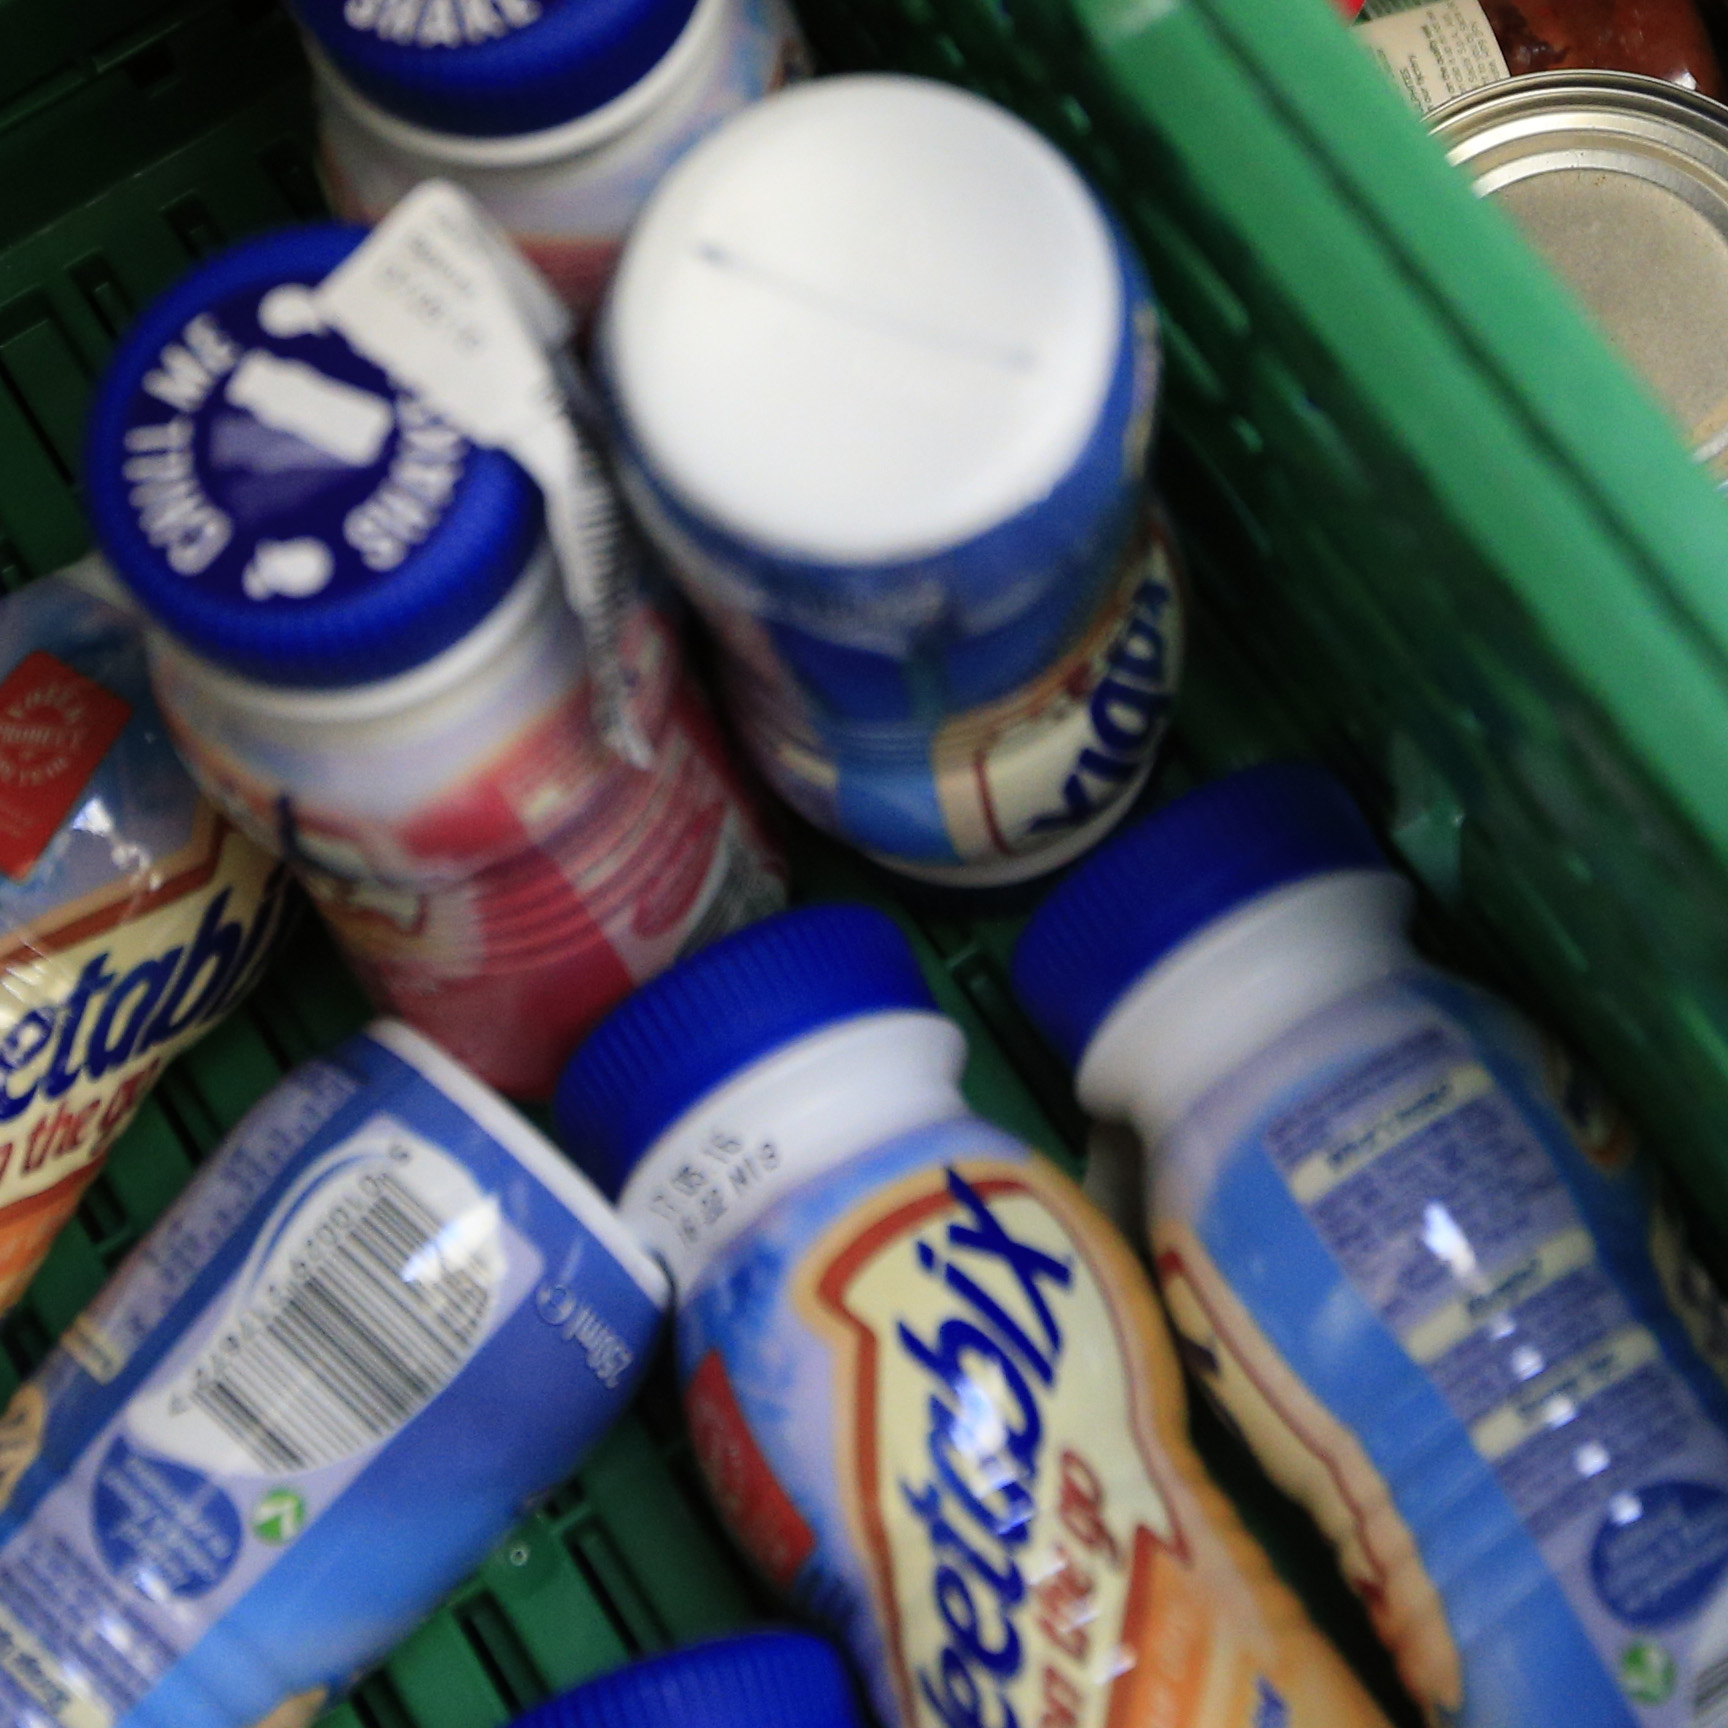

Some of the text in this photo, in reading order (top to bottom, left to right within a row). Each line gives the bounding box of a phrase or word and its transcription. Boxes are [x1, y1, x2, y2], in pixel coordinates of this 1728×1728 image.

[141, 310, 242, 413] ME
[122, 414, 233, 577] CHILL
[21, 1097, 110, 1174] the
